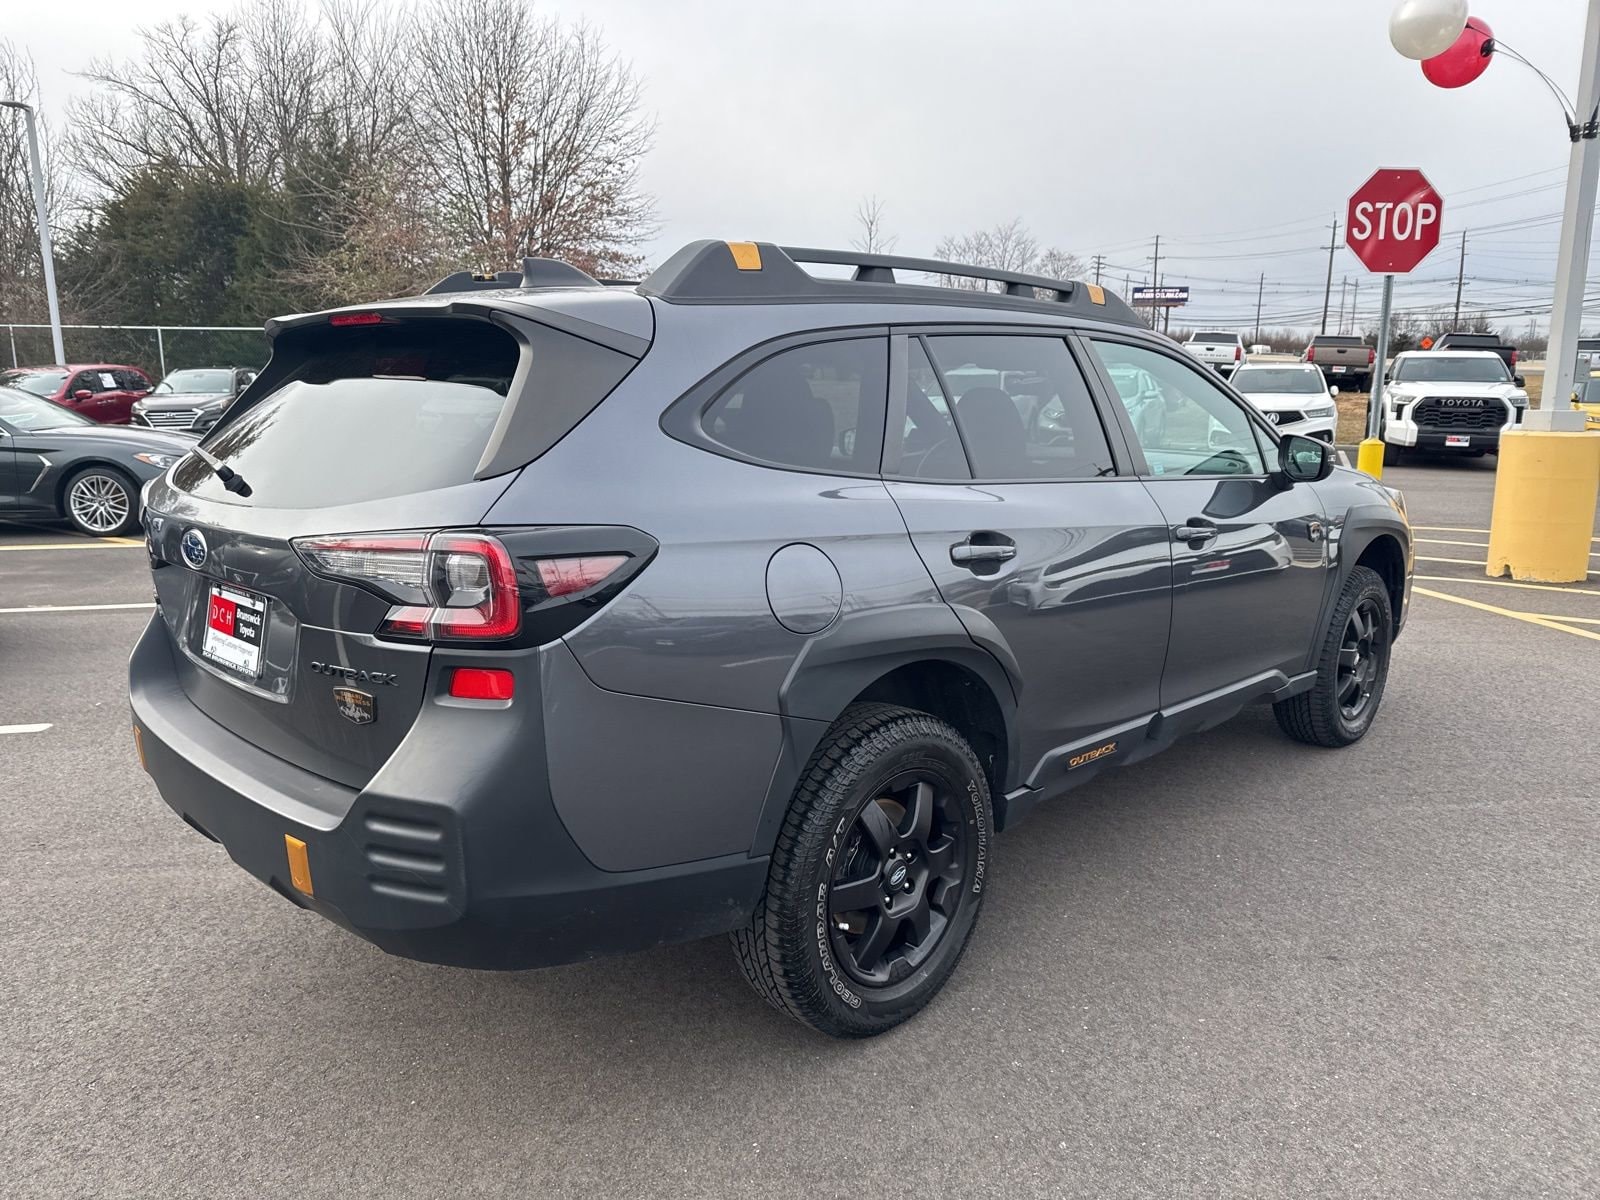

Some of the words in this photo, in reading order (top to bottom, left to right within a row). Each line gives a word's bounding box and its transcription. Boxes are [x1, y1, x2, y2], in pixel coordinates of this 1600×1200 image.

[1352, 201, 1437, 241] STOP
[1440, 399, 1484, 407] TOYOTA
[236, 608, 261, 626] Brunswick
[239, 623, 256, 638] Toyota
[237, 665, 254, 677] TOYOTA
[311, 661, 399, 686] OUTBACK
[1069, 742, 1116, 767] OUTBACK
[967, 779, 987, 893] YOKOHAMA
[816, 882, 861, 1008] GEOLANDAR
